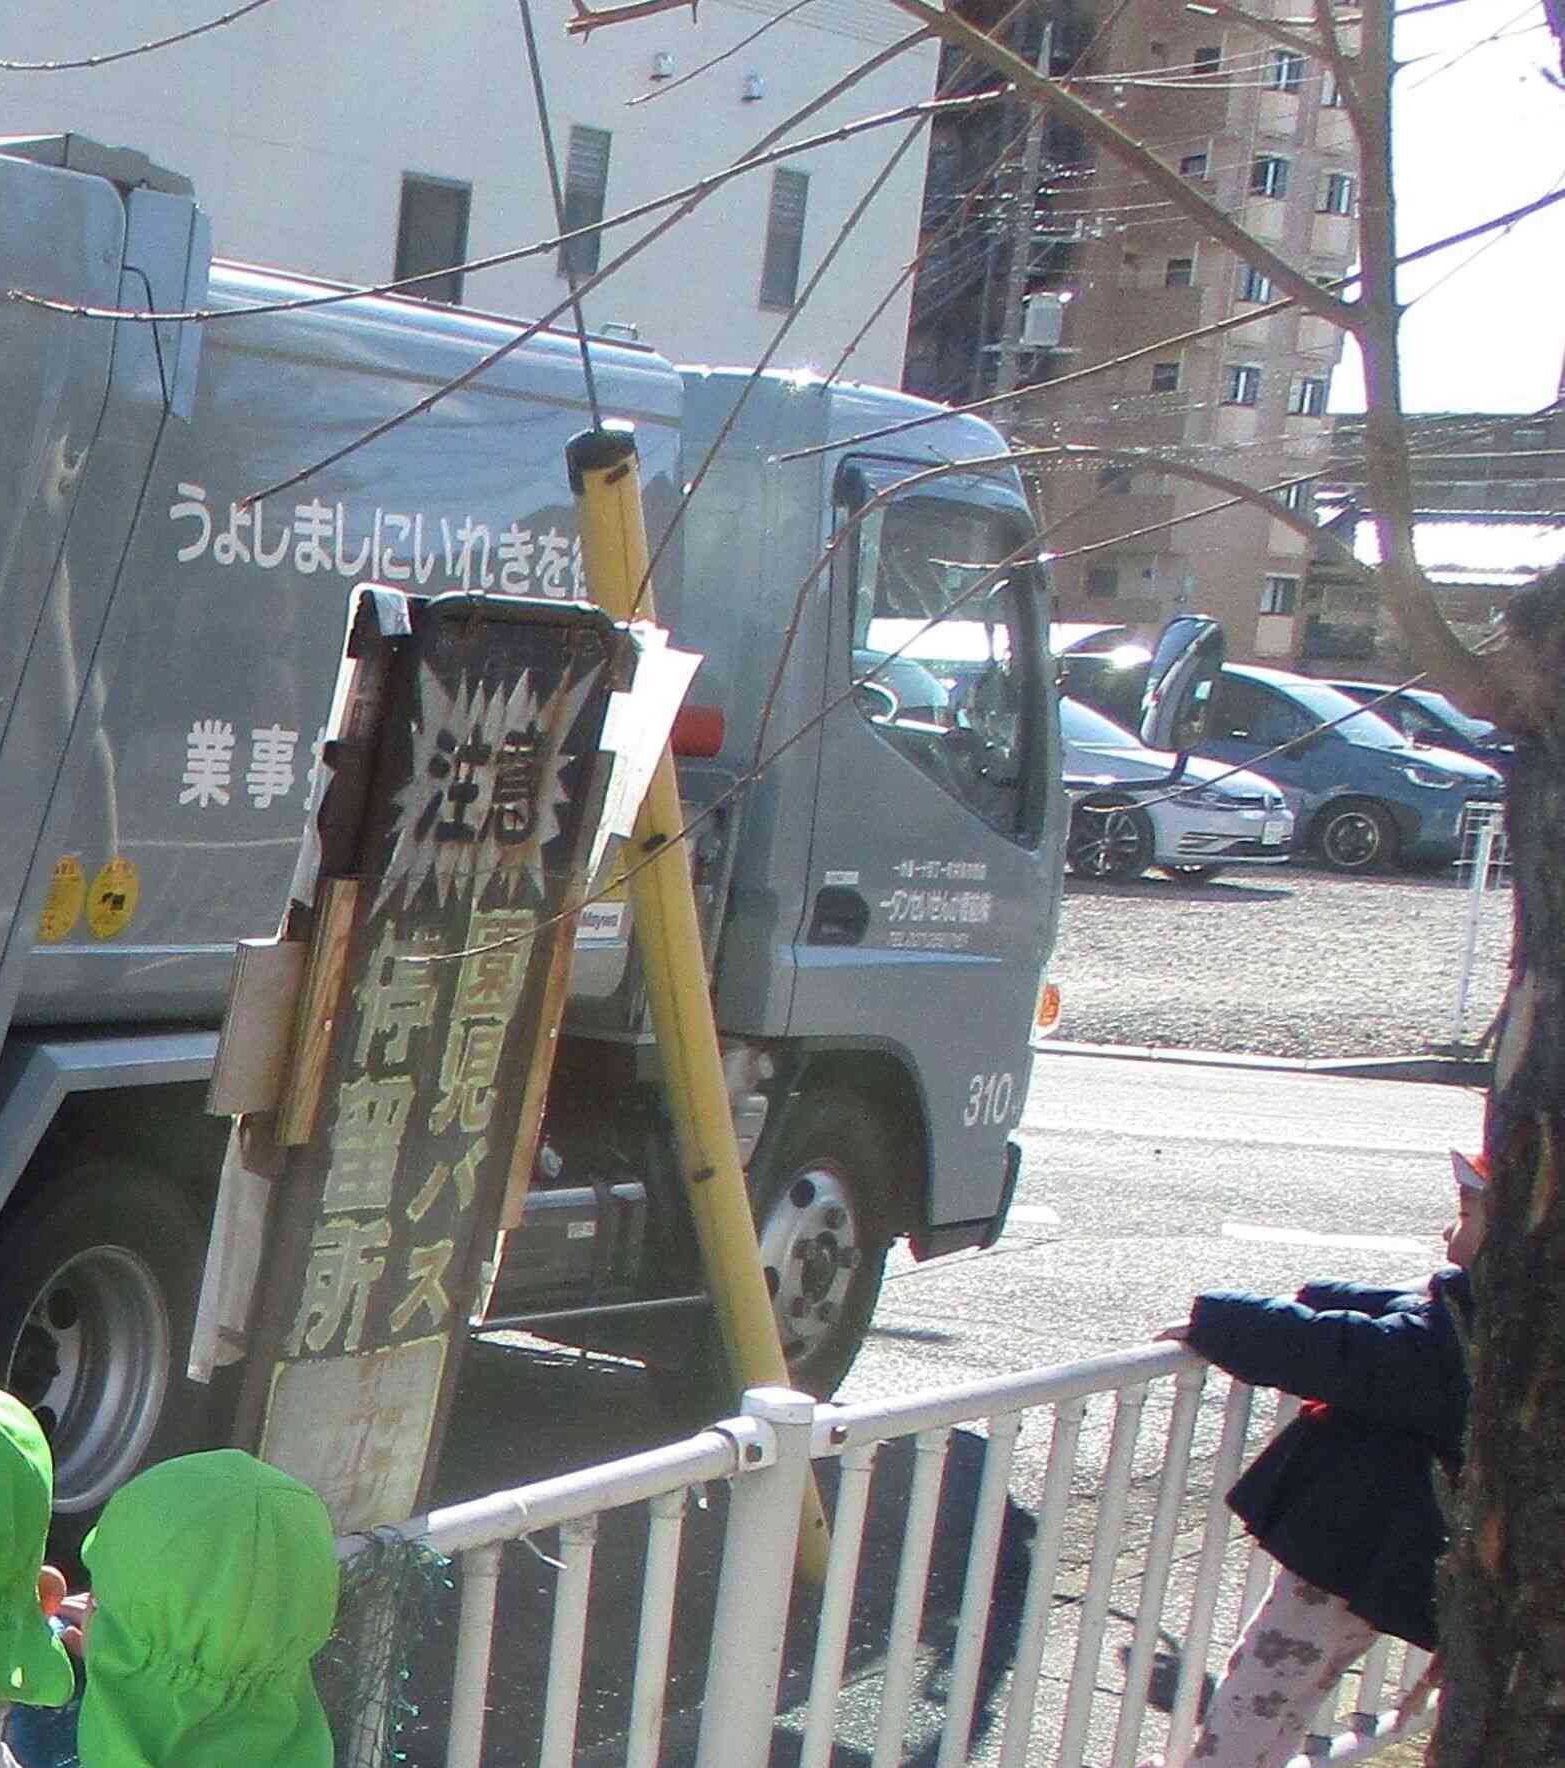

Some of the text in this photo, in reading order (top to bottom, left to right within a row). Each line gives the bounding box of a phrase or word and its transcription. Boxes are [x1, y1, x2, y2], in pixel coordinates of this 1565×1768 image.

[413, 721, 540, 844] 注意
[288, 918, 438, 1357] 停留所
[390, 908, 537, 1333] 園児バス
[963, 1072, 1014, 1127] 310
